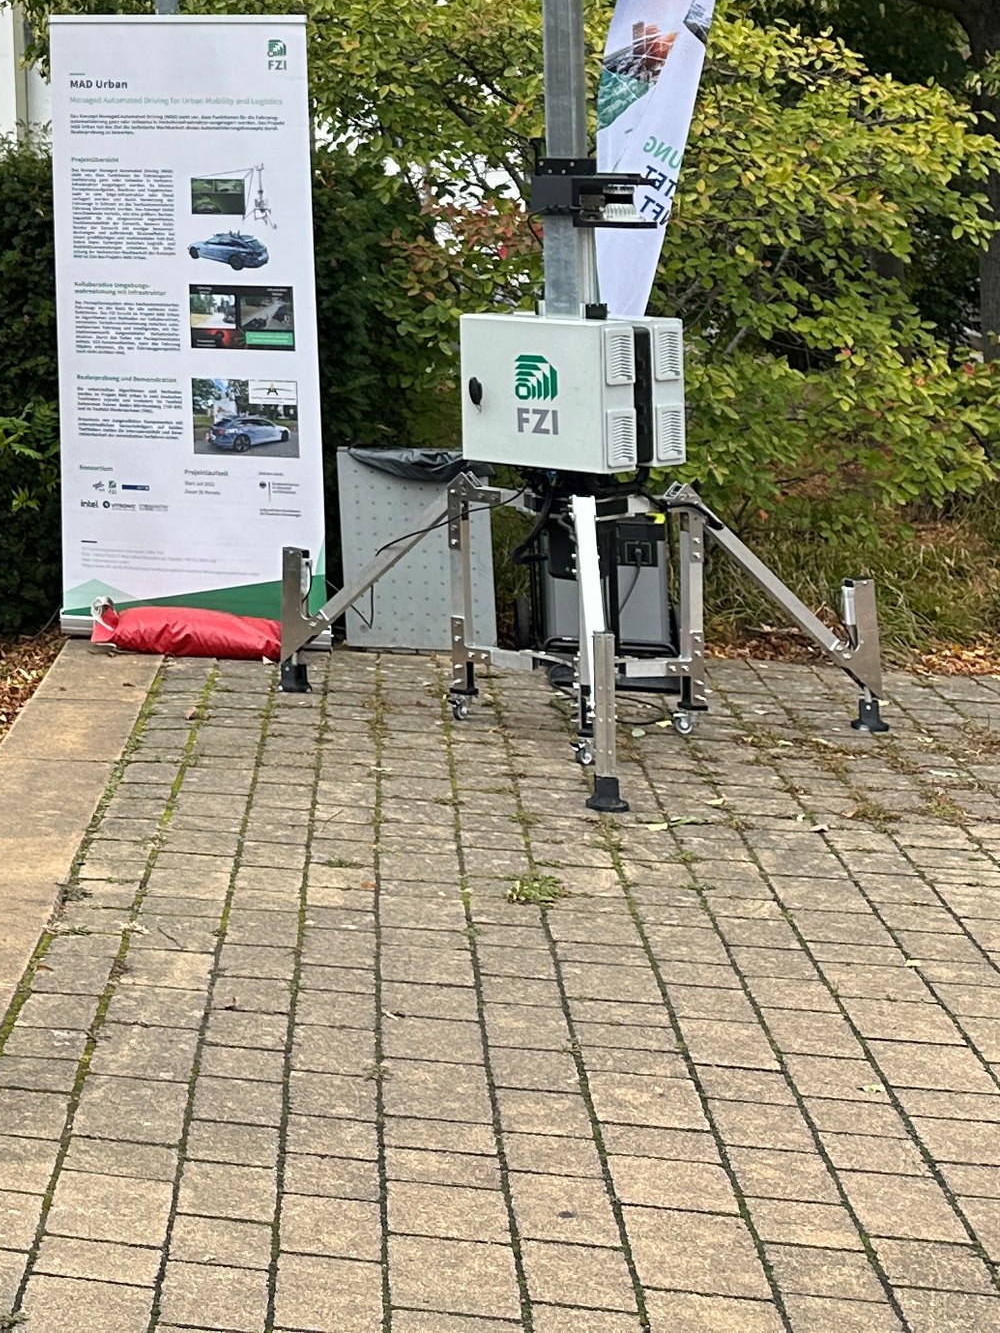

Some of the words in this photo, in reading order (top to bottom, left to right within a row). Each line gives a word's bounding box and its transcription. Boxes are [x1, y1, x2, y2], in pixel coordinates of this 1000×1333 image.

[267, 60, 287, 71] FZI
[70, 79, 93, 89] MAD
[95, 79, 128, 89] Urban
[103, 97, 142, 105] Automated
[144, 97, 169, 106] Driving
[170, 97, 180, 105] for
[182, 97, 204, 105] Urban
[205, 98, 234, 107] Mobility
[251, 98, 283, 107] Logistics
[517, 407, 559, 436] FZI
